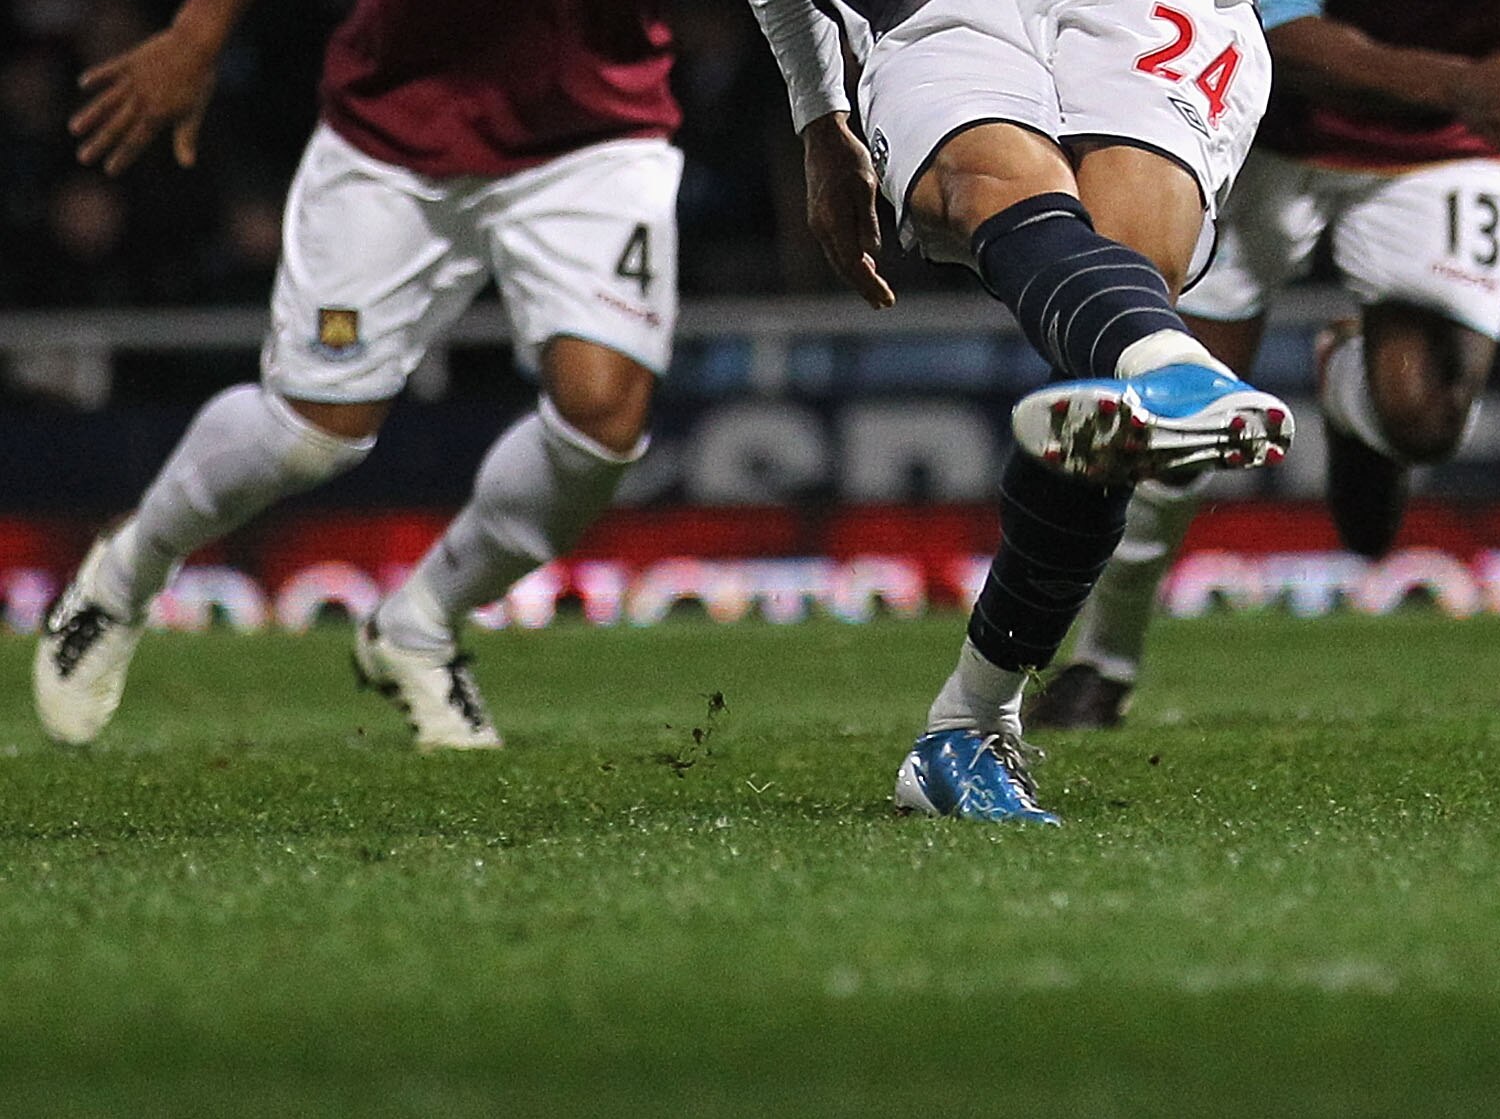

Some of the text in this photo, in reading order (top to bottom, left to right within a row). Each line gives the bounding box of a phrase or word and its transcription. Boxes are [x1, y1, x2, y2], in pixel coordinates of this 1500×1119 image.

[1133, 2, 1243, 129] 24
[615, 221, 655, 298] 4
[1445, 189, 1499, 268] 13
